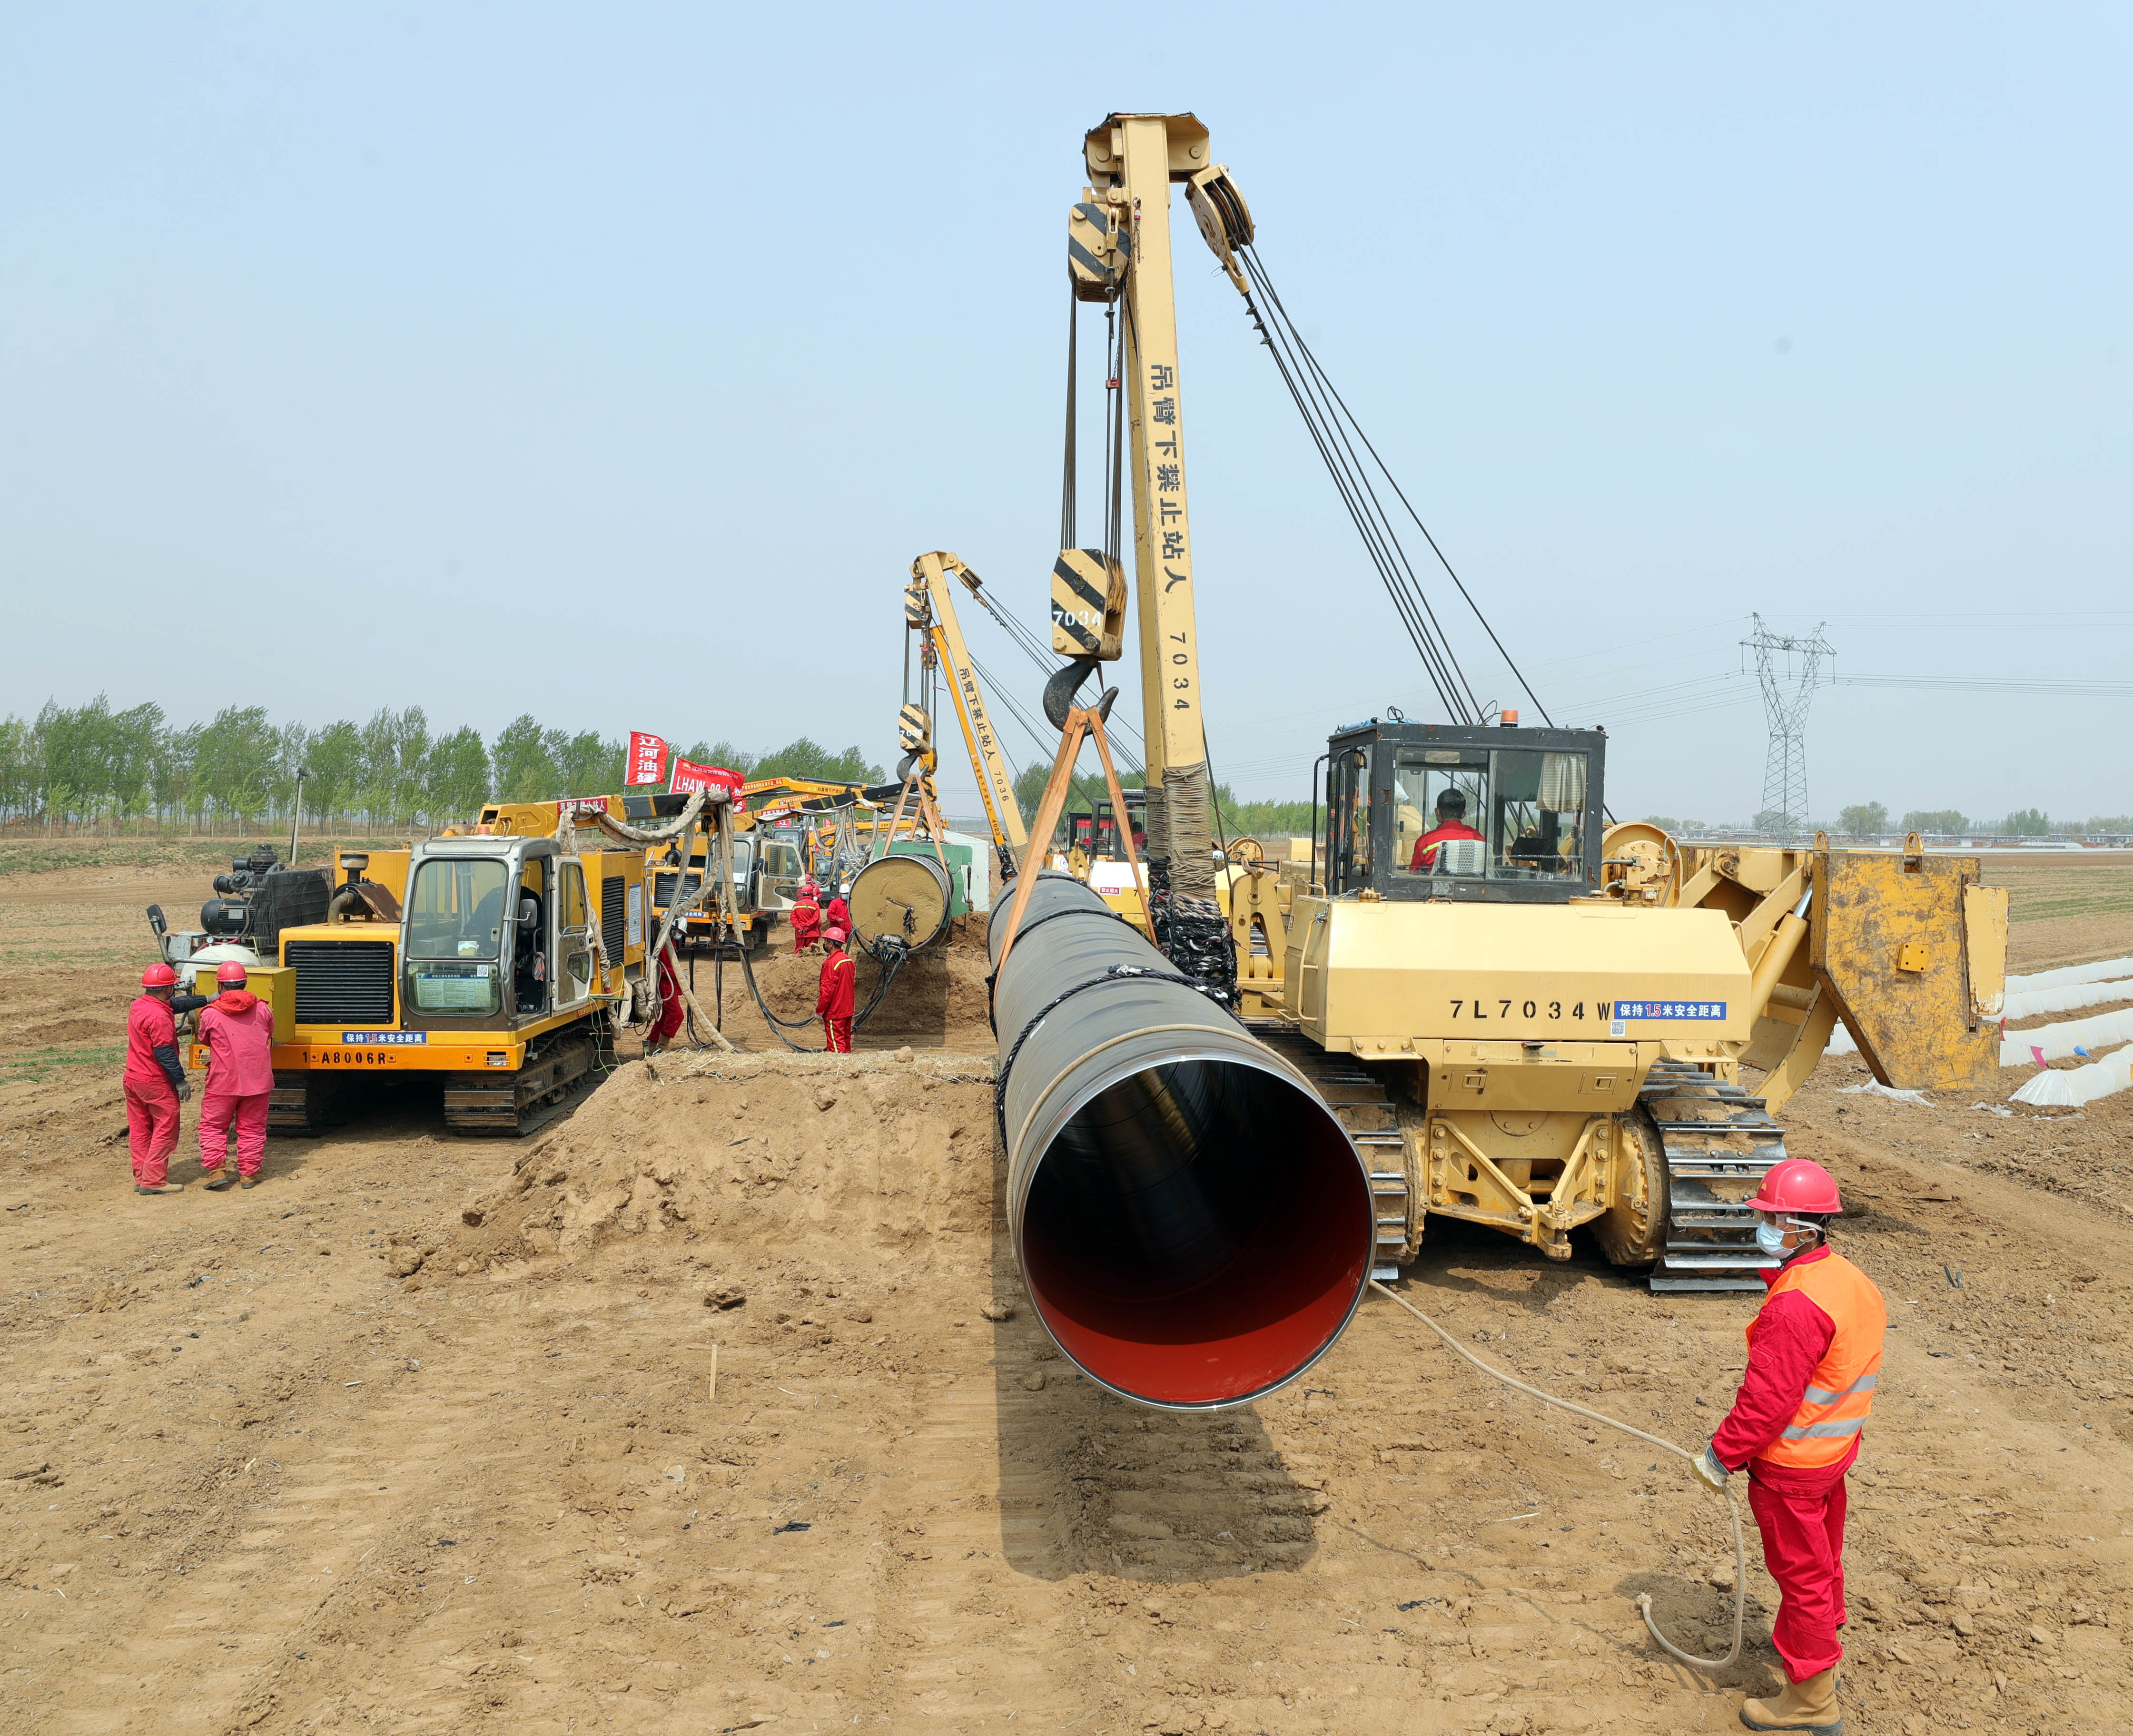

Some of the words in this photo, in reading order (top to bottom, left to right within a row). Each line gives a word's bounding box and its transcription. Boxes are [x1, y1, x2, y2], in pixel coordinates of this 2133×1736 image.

[1151, 364, 1187, 593] 吊臂下禁止站人
[1053, 611, 1101, 627] 7034
[1170, 631, 1190, 710] 7034
[959, 668, 995, 760] 吊臂下禁止站人
[636, 735, 661, 783] 辽河油建
[994, 771, 1008, 801] 7036
[992, 819, 1001, 836] 4023
[1620, 1004, 1721, 1017] 保持1.5米安全距离
[346, 1033, 423, 1044] 保持1.5米安全距离
